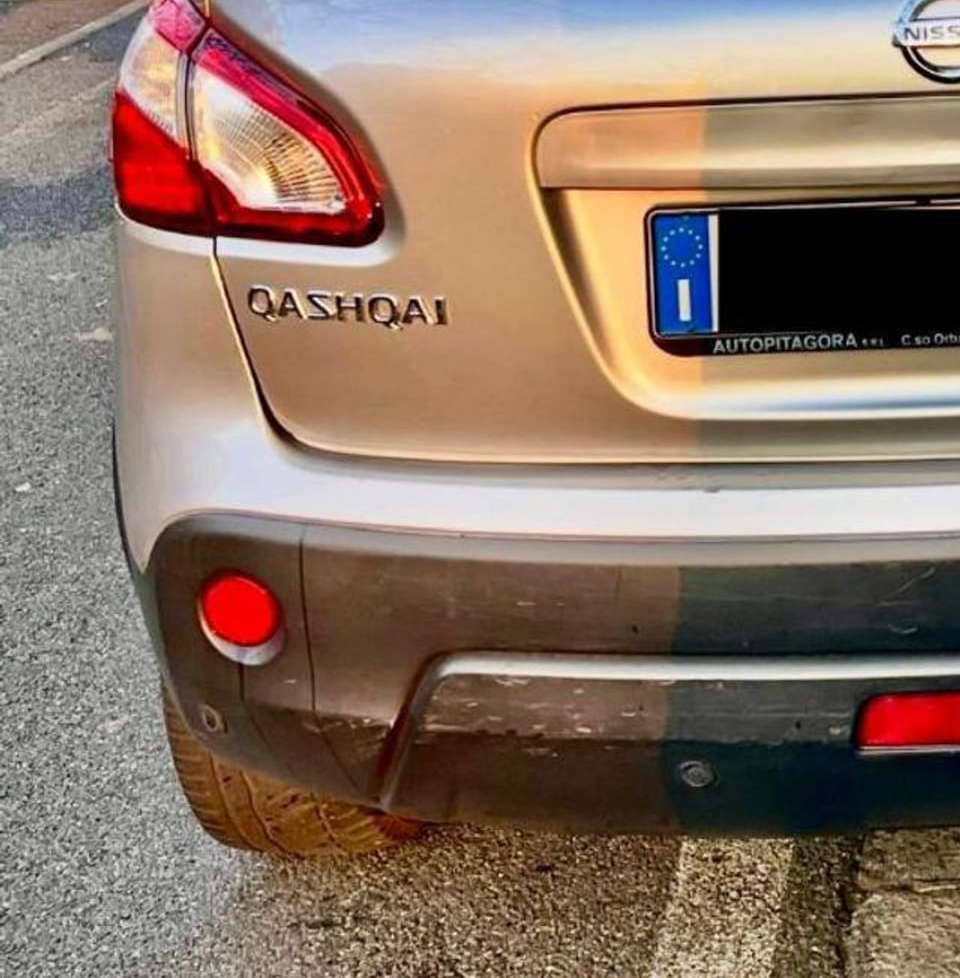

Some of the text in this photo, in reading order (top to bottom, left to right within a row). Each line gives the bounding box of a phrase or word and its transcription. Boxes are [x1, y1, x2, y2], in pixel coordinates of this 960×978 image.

[247, 284, 450, 330] QASHQAI
[677, 278, 692, 321] I
[712, 332, 858, 354] AUTOPITAGORA
